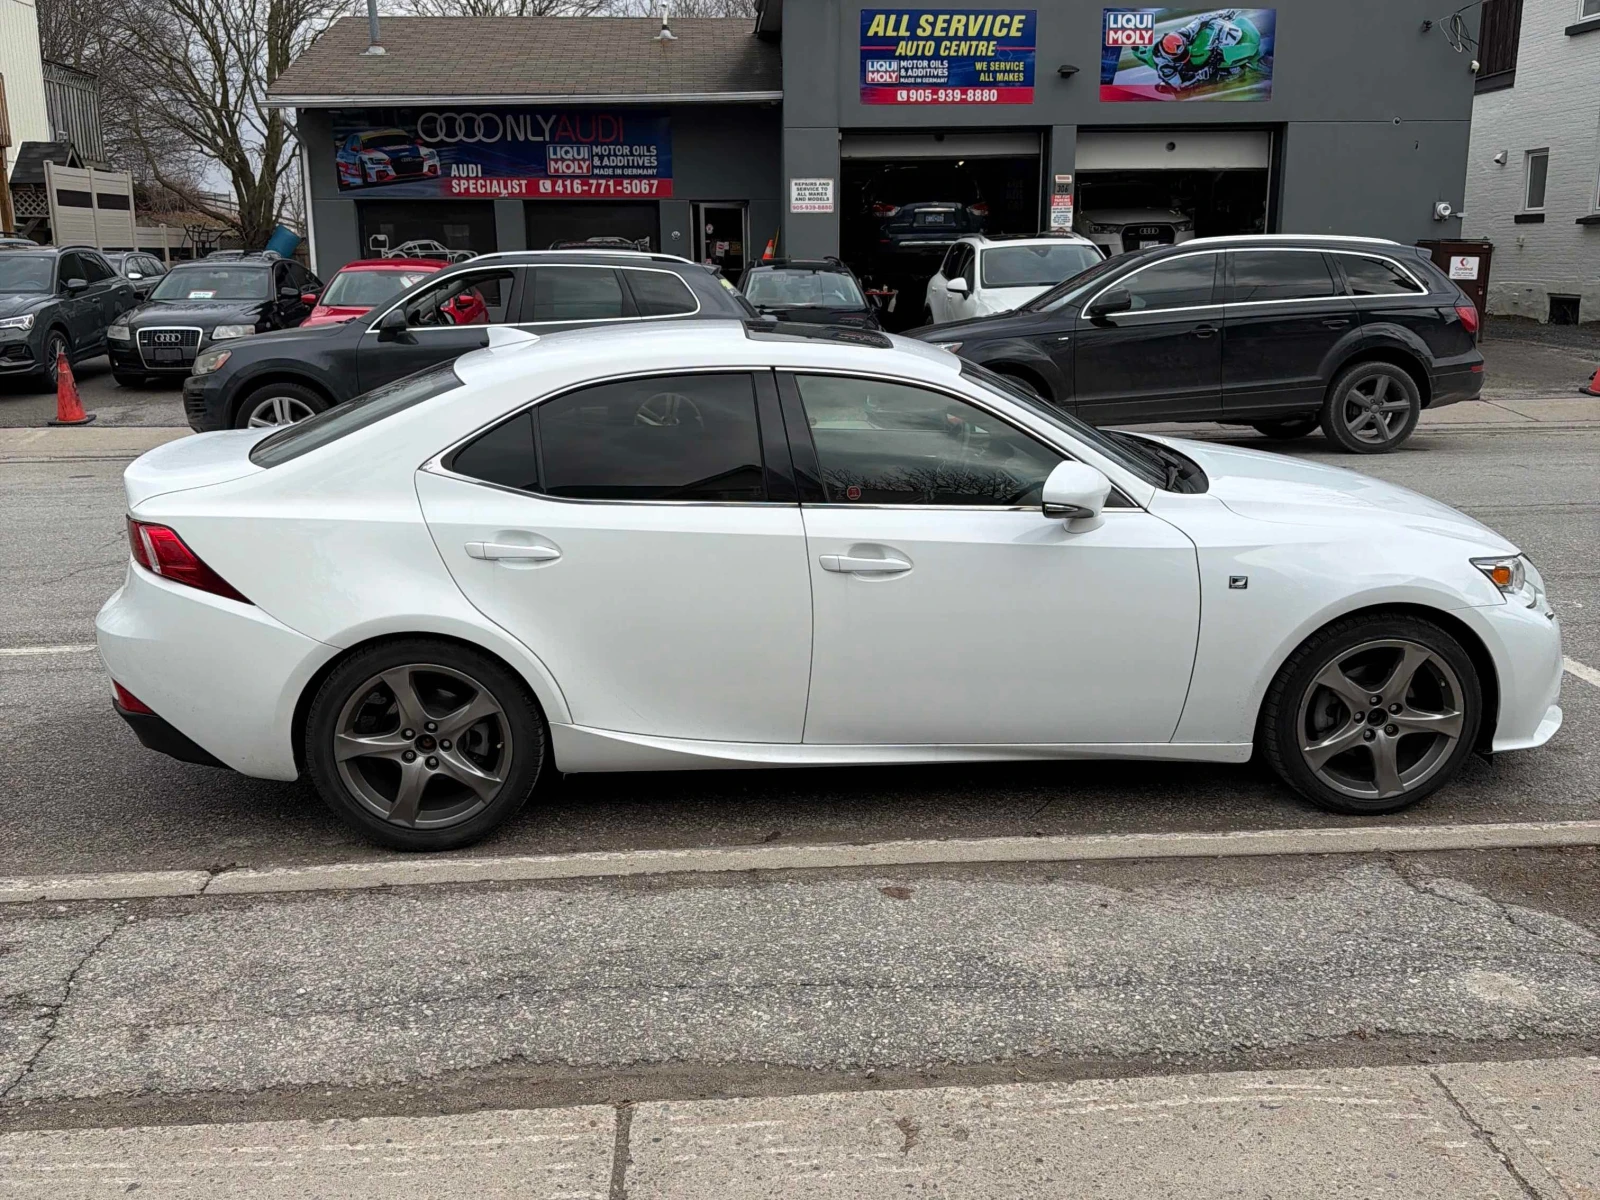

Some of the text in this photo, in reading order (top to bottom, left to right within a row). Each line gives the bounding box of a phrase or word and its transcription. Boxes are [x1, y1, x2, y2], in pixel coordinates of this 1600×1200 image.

[867, 14, 1026, 37] ALL SERVICE
[1109, 14, 1153, 29] LIQUI
[1108, 30, 1153, 45] MOLY
[895, 41, 997, 56] AUTO CENTRE
[868, 61, 898, 71] LIQUI
[900, 60, 949, 68] MOTOR OILS
[975, 61, 1025, 70] WE SERVICE
[868, 72, 898, 82] MOLY
[979, 72, 1024, 81] ALL MAKES
[909, 89, 998, 102] 905-939-8880
[549, 146, 589, 159] LIQUI
[592, 145, 657, 156] MOTOR OILS
[550, 160, 590, 174] MOLY
[592, 156, 658, 166] & ADDITIVES
[450, 164, 482, 177] AUDI
[451, 180, 528, 193] SPECIALIST
[555, 180, 658, 194] 416-771-5067
